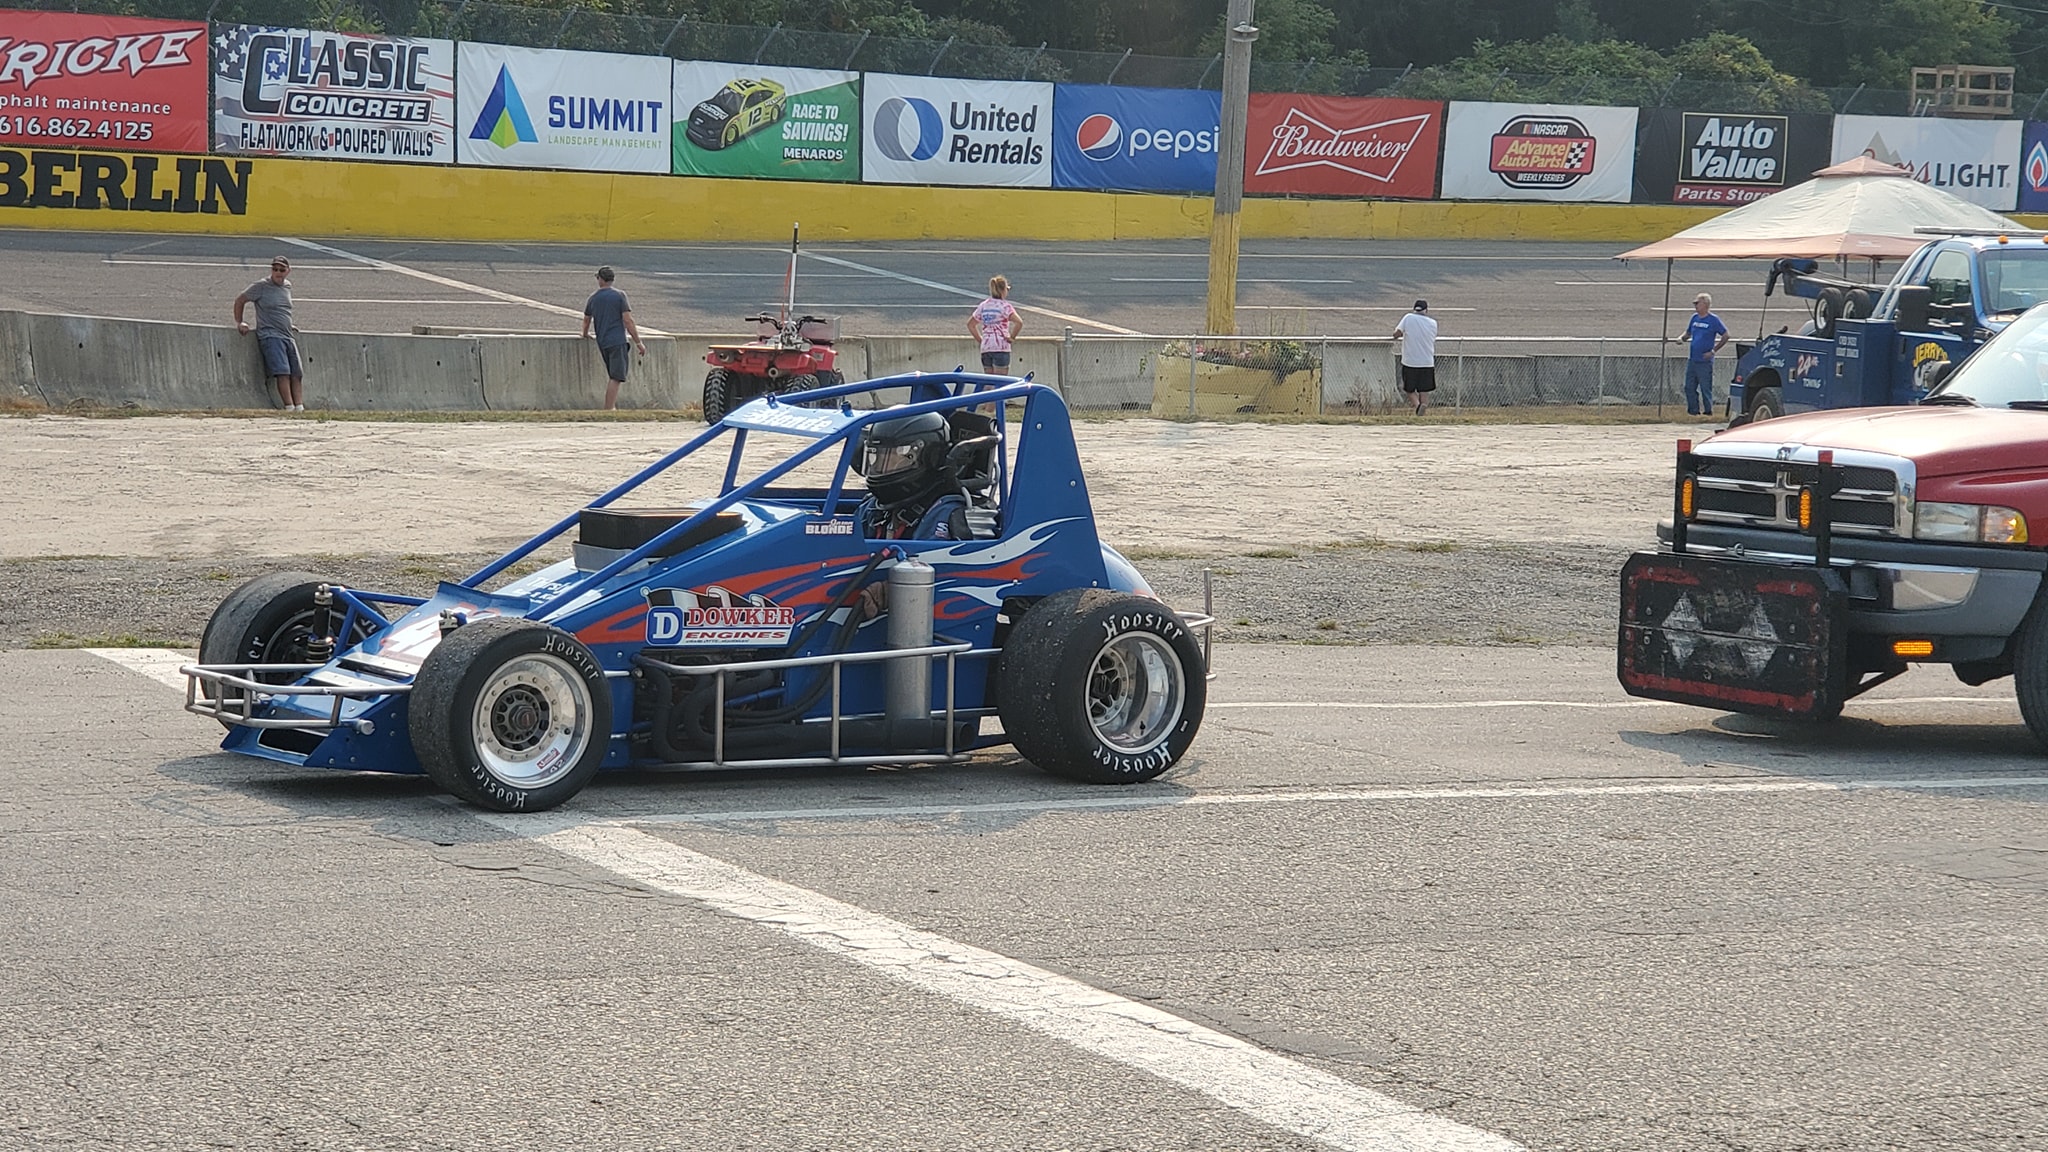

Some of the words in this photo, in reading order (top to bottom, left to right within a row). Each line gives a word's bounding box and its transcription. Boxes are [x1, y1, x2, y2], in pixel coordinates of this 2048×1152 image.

[0, 29, 204, 89] RICKE
[242, 34, 429, 114] CLASSIC
[56, 97, 172, 115] maintenance
[289, 95, 427, 120] CONCRETE
[548, 95, 663, 133] SUMMIT
[747, 106, 763, 127] 12
[791, 103, 823, 120] RACE
[825, 105, 839, 120] TO
[949, 101, 1038, 133] United
[0, 115, 153, 140] 616.862.4125
[241, 122, 315, 151] FLATWORK
[319, 126, 329, 151] &
[334, 127, 387, 155] POURED
[391, 130, 434, 157] WALLS
[782, 120, 849, 142] SAVINGS!
[1272, 124, 1409, 158] Budweiser
[1533, 123, 1569, 136] NASCAR
[1696, 117, 1775, 149] Auto
[547, 135, 599, 146] LANDSCAPE
[601, 137, 663, 149] MANAGEMENT
[783, 147, 844, 160] MENARDS
[948, 134, 1043, 165] Rentals
[1129, 125, 1220, 159] pepsi
[1506, 139, 1566, 156] Advance
[1497, 154, 1530, 168] Auto
[1528, 155, 1563, 169] Parts
[1691, 148, 1777, 180] Value
[1935, 162, 2010, 188] LIGHT
[0, 150, 253, 215] BERLIN
[1516, 172, 1542, 182] WEEKLY
[1542, 173, 1566, 183] SERIES
[1678, 187, 1723, 201] Parts
[805, 524, 854, 535] BLONDE
[652, 612, 680, 640] D
[687, 607, 796, 627] DOWKER
[684, 631, 787, 640] ENGINES
[1102, 612, 1184, 643] Hoosier
[540, 634, 600, 681] Hoosier
[1092, 741, 1173, 773] Hoosier
[471, 763, 529, 809] Hoosier
